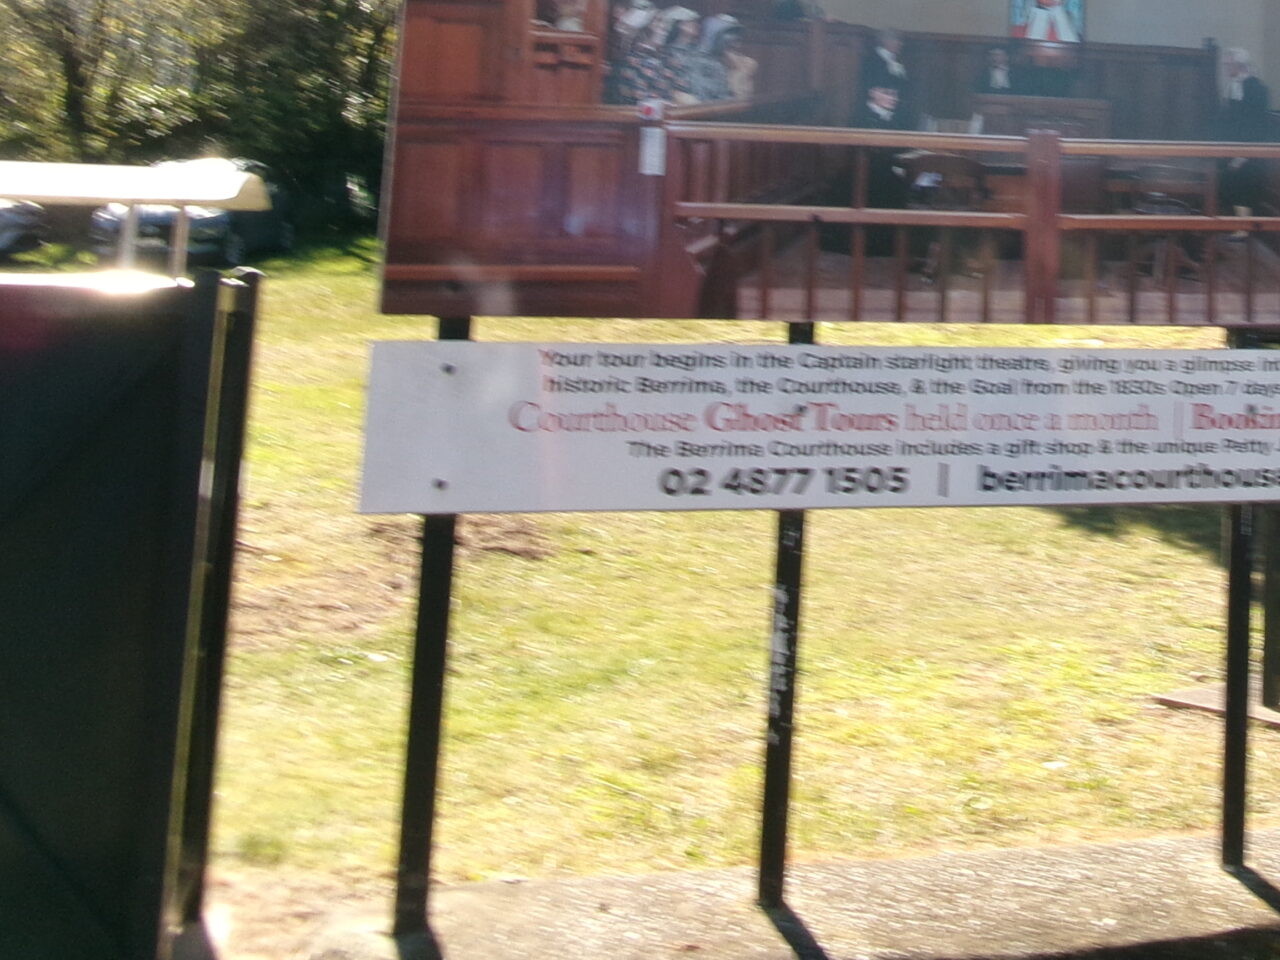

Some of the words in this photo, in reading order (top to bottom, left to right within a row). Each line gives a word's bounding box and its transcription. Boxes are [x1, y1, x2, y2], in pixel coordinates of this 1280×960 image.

[538, 349, 592, 368] Your
[597, 350, 645, 368] tour
[652, 350, 728, 371] begins
[734, 351, 753, 368] in
[755, 351, 794, 369] the
[800, 352, 882, 372] Captain
[884, 352, 973, 373] starlight
[975, 353, 1056, 373] theatre,
[1058, 354, 1119, 374] giving
[1122, 357, 1161, 374] you
[1164, 358, 1177, 371] a
[1180, 354, 1256, 374] glimpse
[543, 375, 634, 394] historic
[635, 376, 732, 395] Berrima,
[735, 376, 773, 394] the
[909, 378, 927, 395] &
[929, 378, 965, 395] the
[1020, 378, 1070, 395] from
[1073, 379, 1107, 395] the
[1168, 379, 1222, 398] Open
[1223, 380, 1238, 395] 7
[508, 400, 698, 432] Courthouse
[703, 401, 805, 432] Ghost
[806, 401, 899, 432] Tours
[902, 402, 969, 432] held
[972, 412, 1039, 431] once
[1044, 412, 1061, 431] a
[1066, 404, 1159, 431] month
[625, 440, 672, 458] The
[675, 440, 765, 458] Berrima
[767, 440, 893, 458] Courthouse
[895, 439, 984, 457] includes
[985, 444, 999, 456] a
[1001, 439, 1043, 458] gift
[1045, 439, 1093, 457] shop
[1096, 439, 1113, 455] &
[1115, 439, 1150, 455] the
[1153, 440, 1219, 457] unique
[1221, 439, 1272, 456] Petty
[658, 466, 712, 497] 02
[719, 466, 816, 496] 4877
[822, 466, 910, 496] 1505
